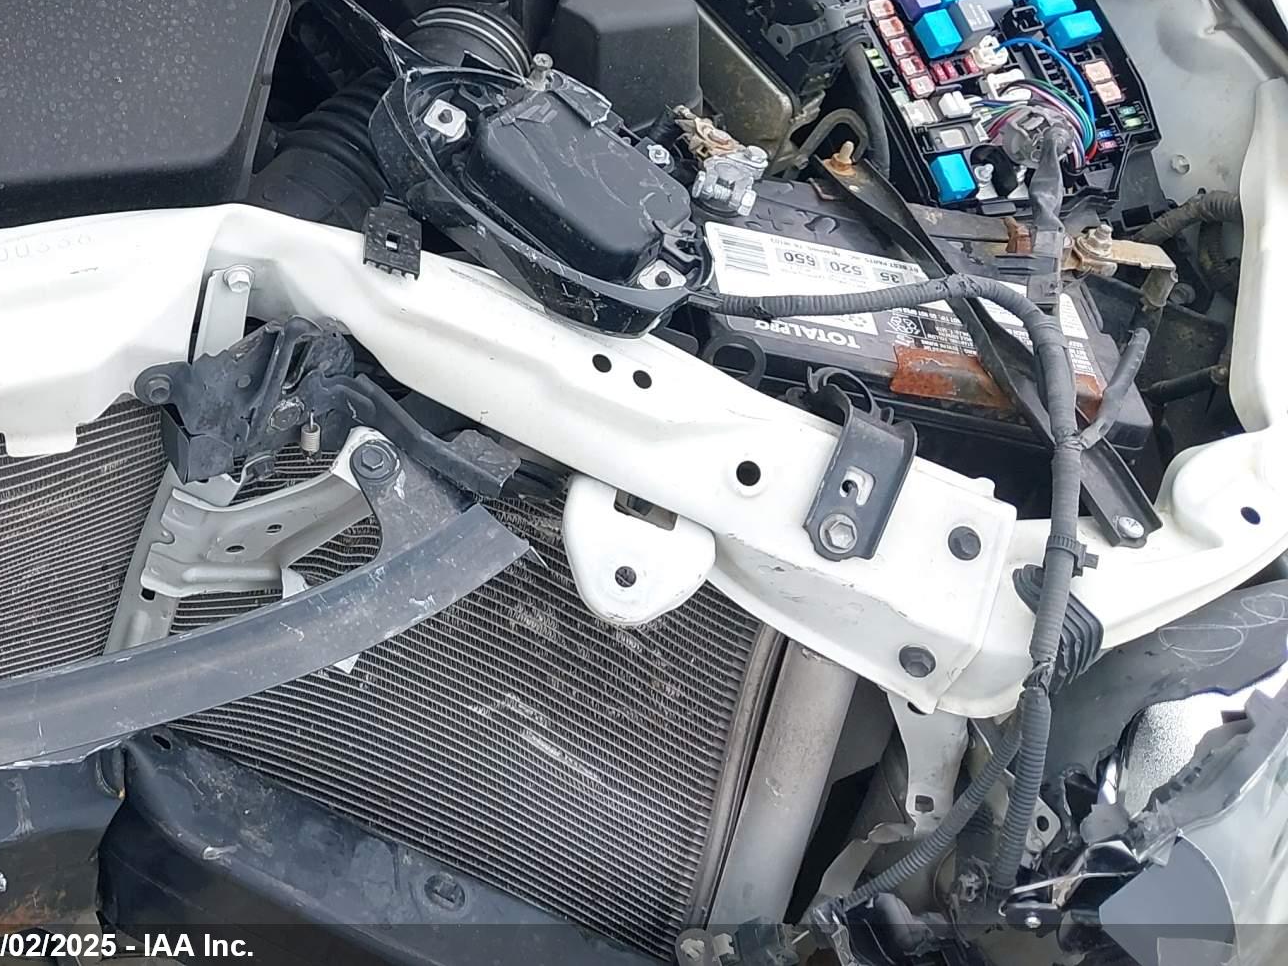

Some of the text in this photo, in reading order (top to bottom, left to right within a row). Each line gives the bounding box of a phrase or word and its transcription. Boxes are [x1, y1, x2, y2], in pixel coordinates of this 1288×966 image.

[783, 252, 816, 267] 650
[830, 261, 863, 276] 520
[879, 272, 900, 284] 35
[754, 319, 861, 350] TOTALPRO
